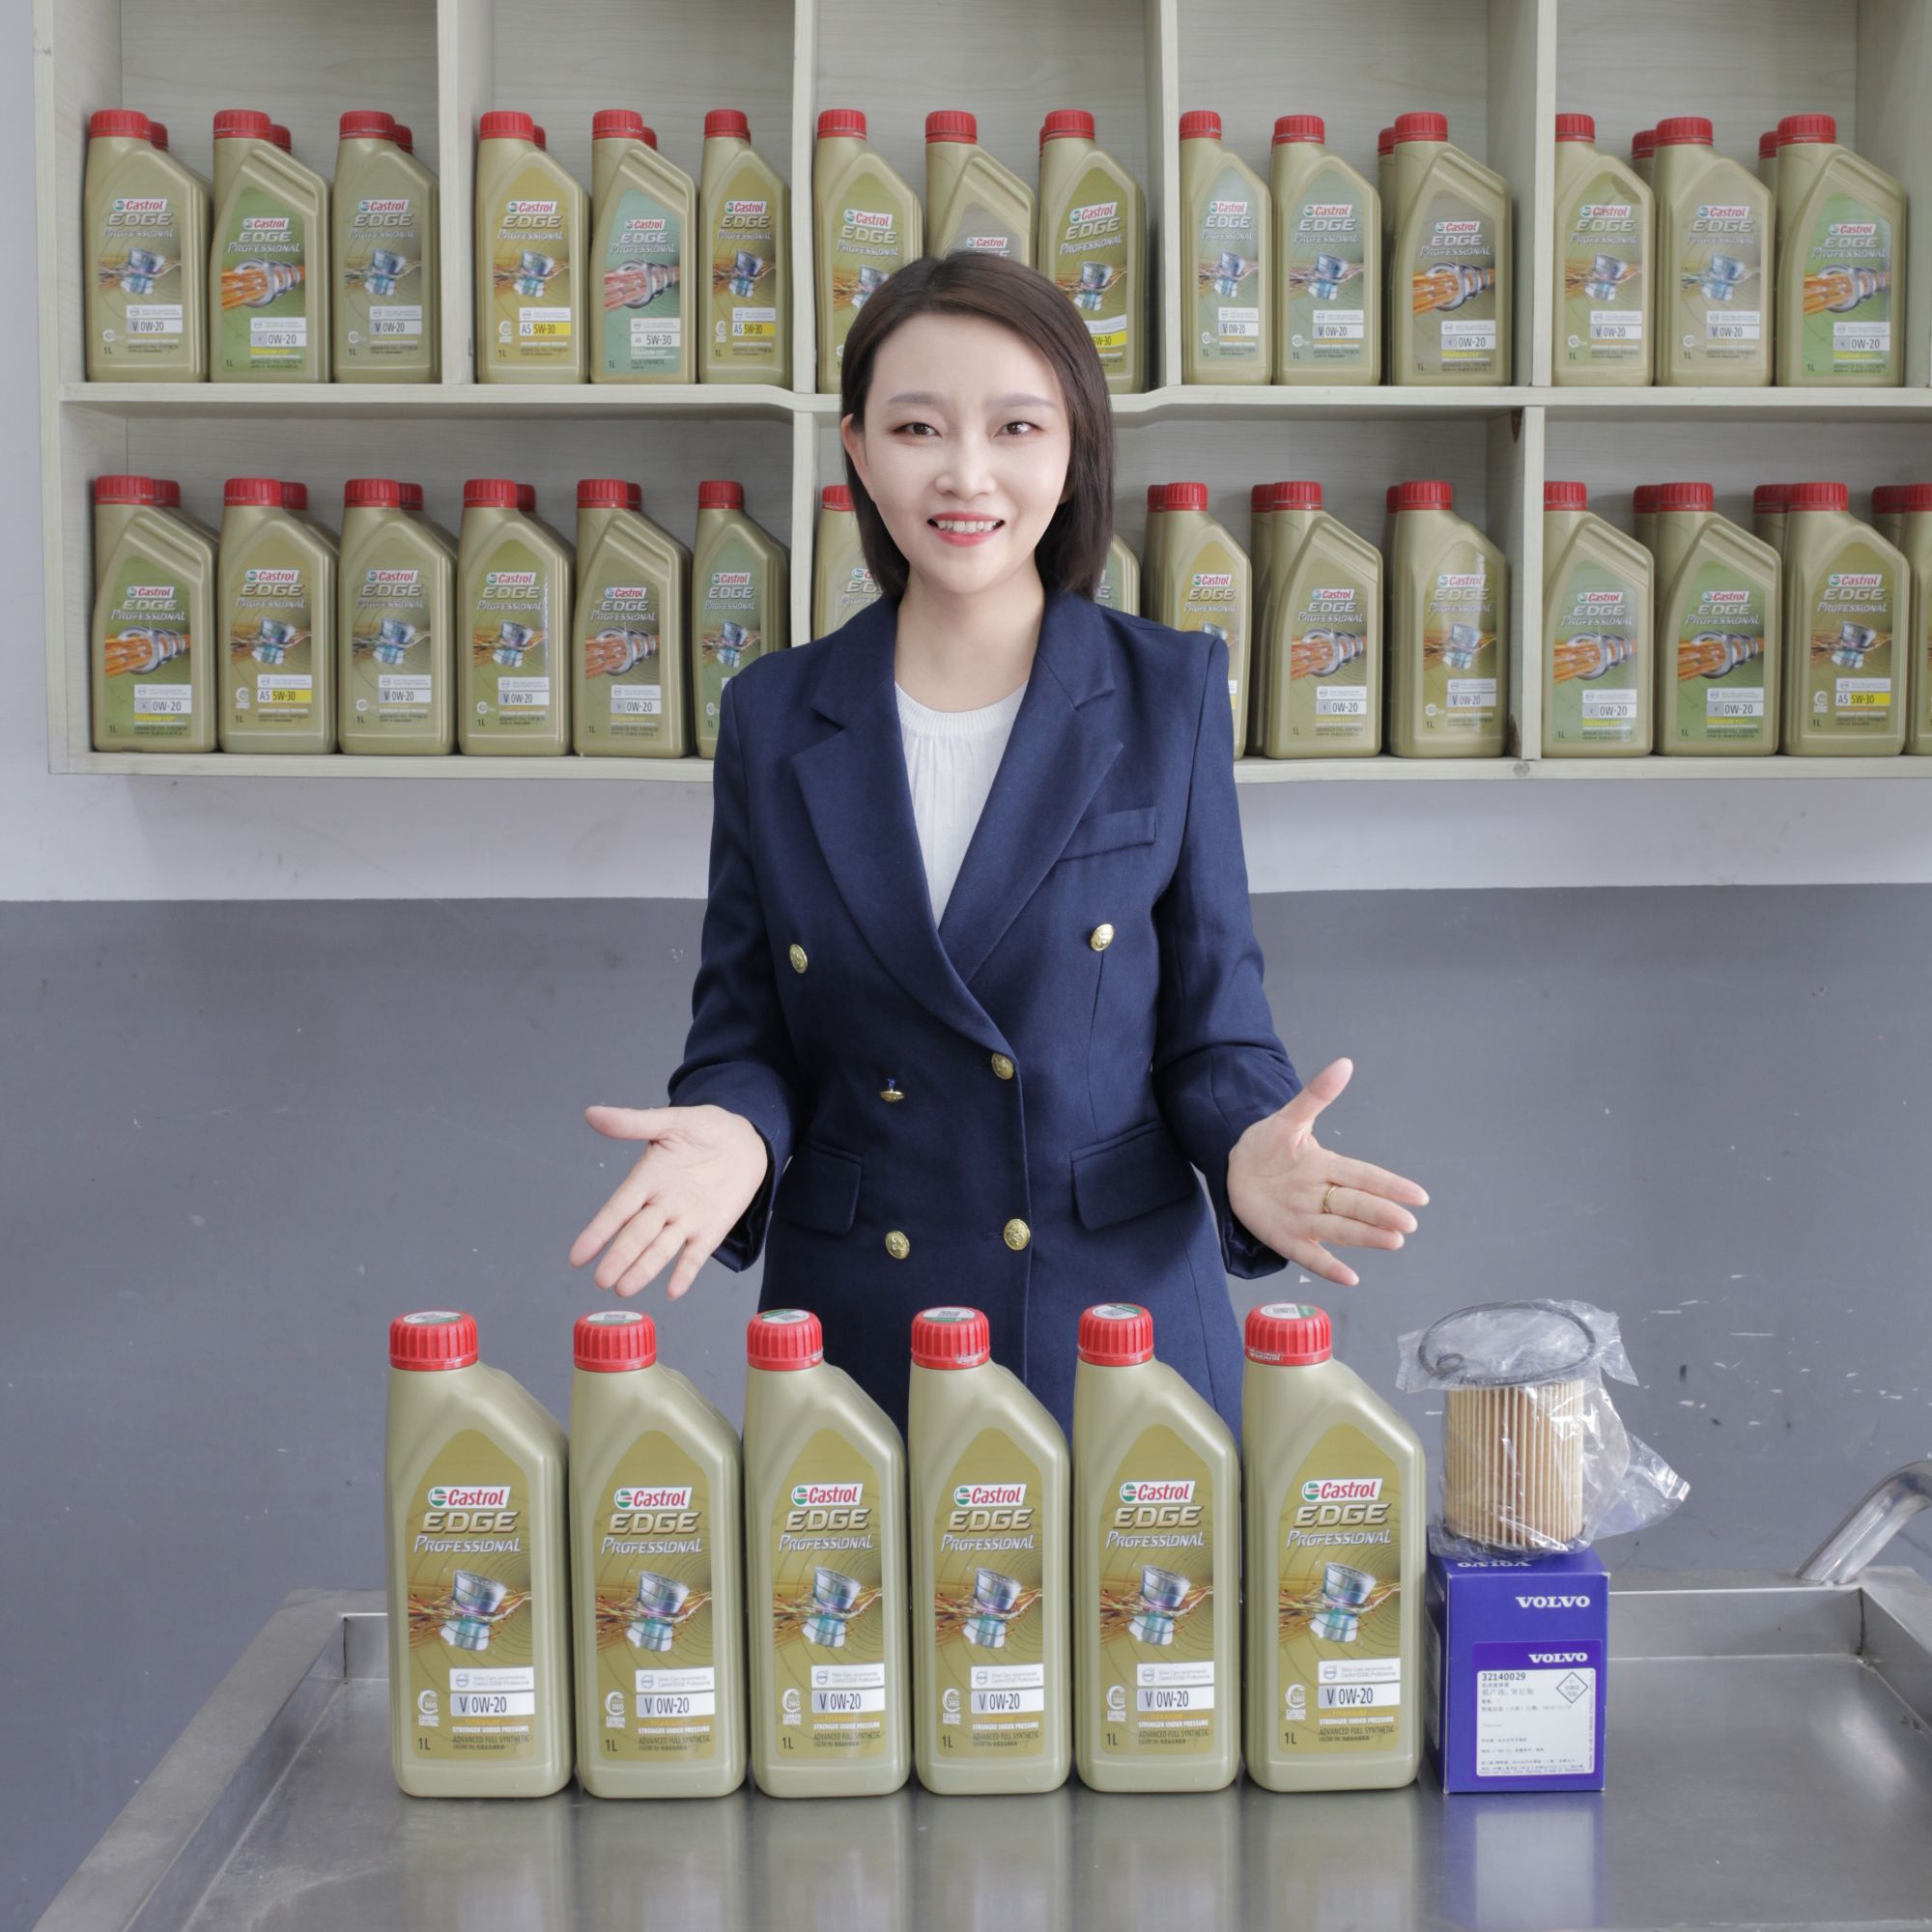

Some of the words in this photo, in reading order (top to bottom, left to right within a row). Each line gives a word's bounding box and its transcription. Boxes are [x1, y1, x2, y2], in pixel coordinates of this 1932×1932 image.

[126, 200, 164, 211] Castrol
[370, 201, 405, 212] Castrol
[519, 202, 553, 213] Castrol
[734, 202, 764, 213] Castrol
[1218, 202, 1245, 213] Castrol
[1315, 206, 1349, 216] Castrol
[1081, 205, 1114, 220] Castrol
[1592, 207, 1628, 217] Castrol
[1710, 207, 1746, 217] Castrol
[108, 213, 172, 226] EDGE
[252, 219, 286, 229] Castrol
[355, 214, 413, 226] EDGE
[503, 215, 560, 228] EDGE
[722, 216, 769, 228] EDGE
[856, 213, 890, 225] Castrol
[1206, 216, 1251, 229] EDGE
[635, 220, 663, 230] Castrol
[1065, 217, 1121, 241] EDGE
[1299, 219, 1355, 231] EDGE
[1445, 222, 1477, 232] Castrol
[1576, 220, 1634, 232] EDGE
[1691, 220, 1753, 233] EDGE
[1839, 224, 1873, 234] Castrol
[240, 232, 292, 242] EDGE
[620, 233, 668, 242] EDGE
[841, 226, 897, 243] EDGE
[1432, 235, 1482, 245] EDGE
[976, 238, 1006, 247] Castrol
[1824, 238, 1877, 247] EDGE
[140, 321, 164, 331] 0W-20
[383, 322, 405, 332] 0W-20
[533, 324, 555, 334] 5W-30
[744, 324, 762, 334] 5W-30
[1229, 324, 1246, 334] 0W-20
[1325, 326, 1348, 336] 0W-20
[1604, 327, 1626, 337] 0W-20
[1719, 327, 1743, 337] 0W-20
[269, 334, 297, 345] 0W-20
[646, 335, 672, 345] 5W-30
[1458, 337, 1486, 348] 0W-20
[1851, 339, 1880, 350] 0W-20
[259, 571, 296, 582] Castrol
[379, 571, 414, 582] Castrol
[497, 573, 532, 583] Castrol
[720, 574, 748, 583] Castrol
[1202, 575, 1230, 585] Castrol
[1449, 576, 1483, 586] Castrol
[1840, 576, 1878, 586] Castrol
[138, 587, 171, 597] Castrol
[242, 584, 303, 597] EDGE
[362, 584, 422, 597] EDGE
[482, 587, 540, 599] EDGE
[614, 588, 643, 598] Castrol
[708, 587, 753, 599] EDGE
[1188, 588, 1235, 601] EDGE
[1322, 590, 1350, 600] Castrol
[1433, 589, 1490, 601] EDGE
[1824, 588, 1886, 601] EDGE
[1587, 593, 1620, 603] Castrol
[1712, 592, 1746, 602] Castrol
[123, 600, 176, 611] EDGE
[601, 601, 648, 611] EDGE
[1308, 602, 1356, 612] EDGE
[1573, 606, 1625, 615] EDGE
[1698, 605, 1751, 614] EDGE
[272, 691, 296, 701] 5W-30
[391, 691, 414, 701] 0W-20
[510, 694, 533, 703] 0W-20
[1460, 695, 1481, 705] 0W-20
[1851, 694, 1874, 704] 5W-30
[153, 701, 182, 712] 0W-20
[627, 701, 652, 712] 0W-20
[1332, 702, 1358, 713] 0W-20
[1600, 705, 1628, 716] 0W-20
[1724, 704, 1753, 715] 0W-20
[1137, 1483, 1189, 1500] Castrol
[1321, 1481, 1376, 1498] Castrol
[448, 1490, 504, 1506] Castrol
[633, 1490, 687, 1507] Castrol
[809, 1487, 857, 1504] Castrol
[972, 1487, 1020, 1504] Castrol
[785, 1509, 870, 1531] EDGE
[947, 1509, 1034, 1531] EDGE
[1113, 1506, 1204, 1527] EDGE
[1294, 1504, 1390, 1526] EDGE
[422, 1512, 520, 1533] EDGE
[609, 1513, 700, 1534] EDGE
[1516, 1596, 1590, 1607] VOLVO
[1528, 1653, 1588, 1662] VOLVO
[819, 1695, 827, 1710] V
[830, 1693, 861, 1710] 0W-20
[979, 1695, 985, 1709] V
[989, 1693, 1020, 1710] 0W-20
[1146, 1692, 1152, 1707] V
[1156, 1690, 1189, 1707] 0W-20
[1326, 1690, 1334, 1704] V
[1339, 1688, 1374, 1704] 0W-20
[459, 1697, 468, 1713] V
[471, 1696, 507, 1713] 0W-20
[644, 1698, 652, 1713] V
[656, 1696, 690, 1714] 0W-20
[1138, 1730, 1167, 1739] ADVANCED
[1181, 1728, 1208, 1738] SYNTHETIC
[1320, 1727, 1350, 1736] ADVANCED
[1365, 1725, 1394, 1735] SYNTHETIC
[418, 1738, 431, 1749] 1L
[452, 1735, 484, 1744] ADVANCED
[485, 1735, 498, 1744] FULL
[499, 1734, 529, 1743] SYNTHETIC
[639, 1736, 668, 1745] ADVANCED
[668, 1736, 681, 1745] FULL
[682, 1735, 711, 1744] SYNTHETIC
[782, 1737, 793, 1749] 1L
[942, 1736, 952, 1747] 1L
[1106, 1733, 1118, 1746] 1L
[1285, 1732, 1296, 1745] 1L
[606, 1739, 617, 1751] 1L
